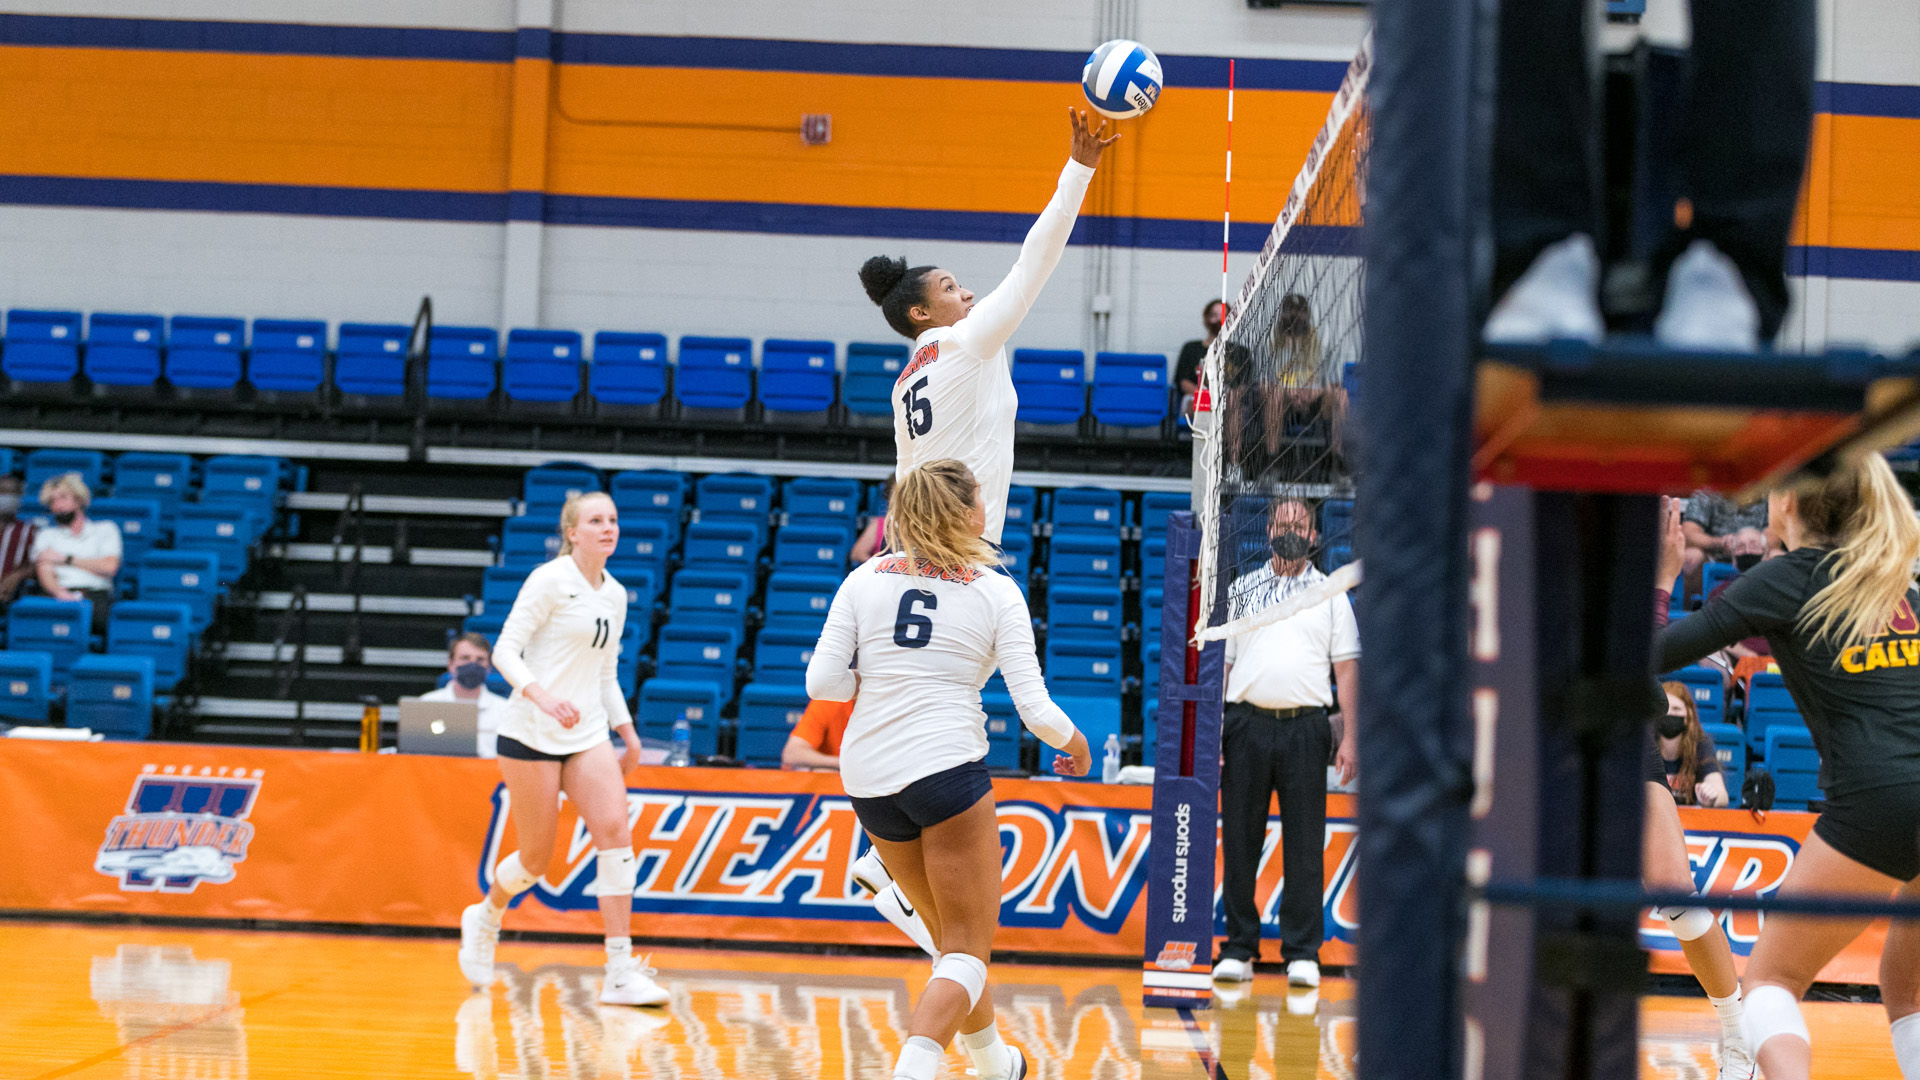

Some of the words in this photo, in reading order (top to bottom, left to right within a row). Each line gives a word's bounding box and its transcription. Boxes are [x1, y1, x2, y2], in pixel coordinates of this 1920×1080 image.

[902, 375, 933, 440] 15
[591, 618, 609, 649] 11
[893, 588, 938, 648] 6
[103, 818, 251, 858] THUNDER
[485, 788, 1152, 919] WHEAON
[1174, 803, 1191, 856] sports
[1171, 858, 1188, 923] imports
